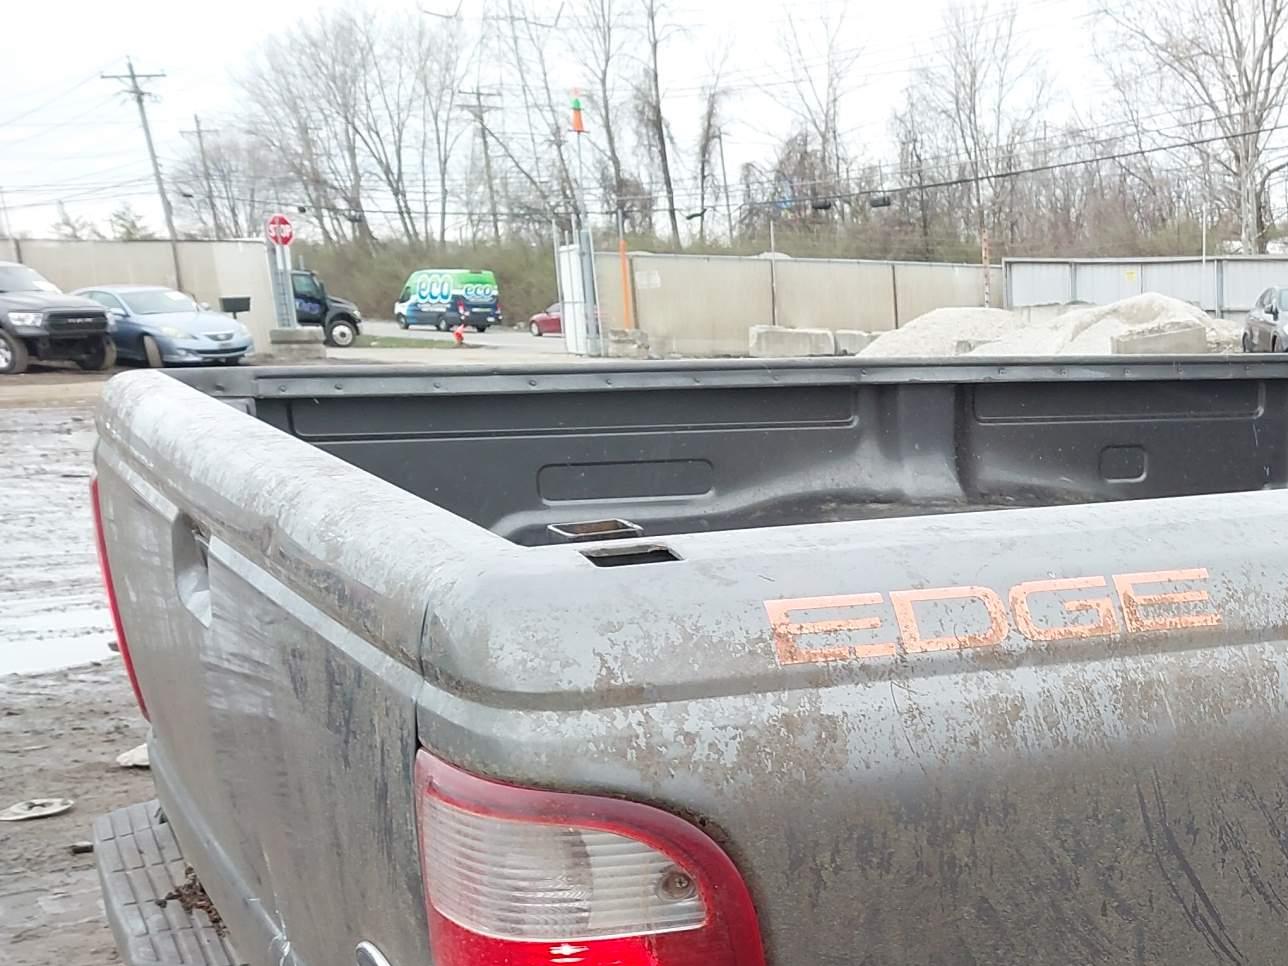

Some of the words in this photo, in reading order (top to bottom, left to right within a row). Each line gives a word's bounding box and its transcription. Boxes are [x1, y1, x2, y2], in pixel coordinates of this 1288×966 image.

[268, 223, 292, 238] STOP
[418, 275, 452, 301] eco
[464, 285, 492, 298] eco
[763, 567, 1224, 666] EDGE
